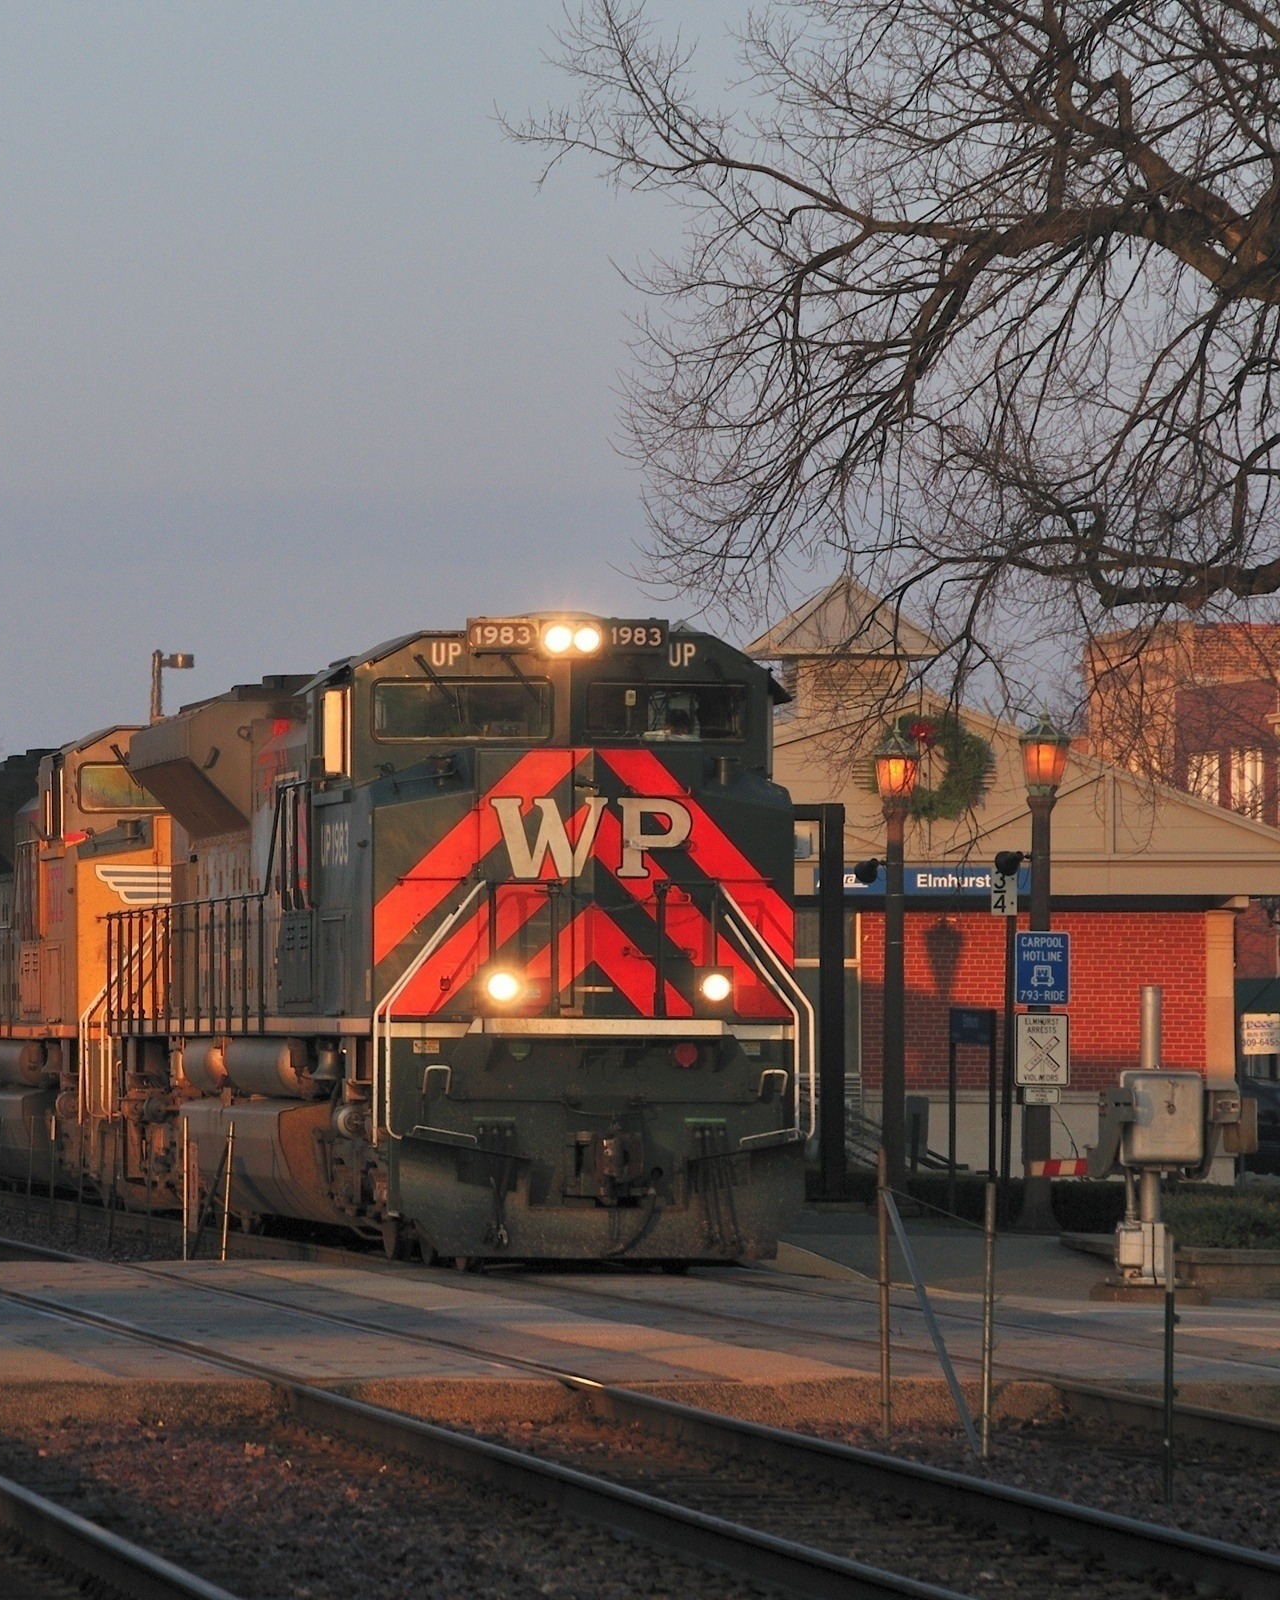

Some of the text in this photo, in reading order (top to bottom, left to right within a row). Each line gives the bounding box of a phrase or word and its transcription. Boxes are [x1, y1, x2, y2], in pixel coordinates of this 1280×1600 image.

[475, 626, 531, 645] 1983
[611, 626, 662, 646] 1983
[432, 642, 462, 666] UP
[669, 643, 696, 667] UP
[489, 797, 692, 878] WP
[917, 873, 991, 888] Elmhurst
[993, 894, 1006, 913] 4
[1021, 936, 1064, 948] CARPOOL
[1022, 951, 1063, 962] HOTLINE
[1020, 989, 1065, 1001] 793-RIDE
[1024, 1017, 1059, 1026] ELMHURST
[1027, 1026, 1057, 1034] ARRESTS
[1023, 1074, 1059, 1082] VIOLATORS
